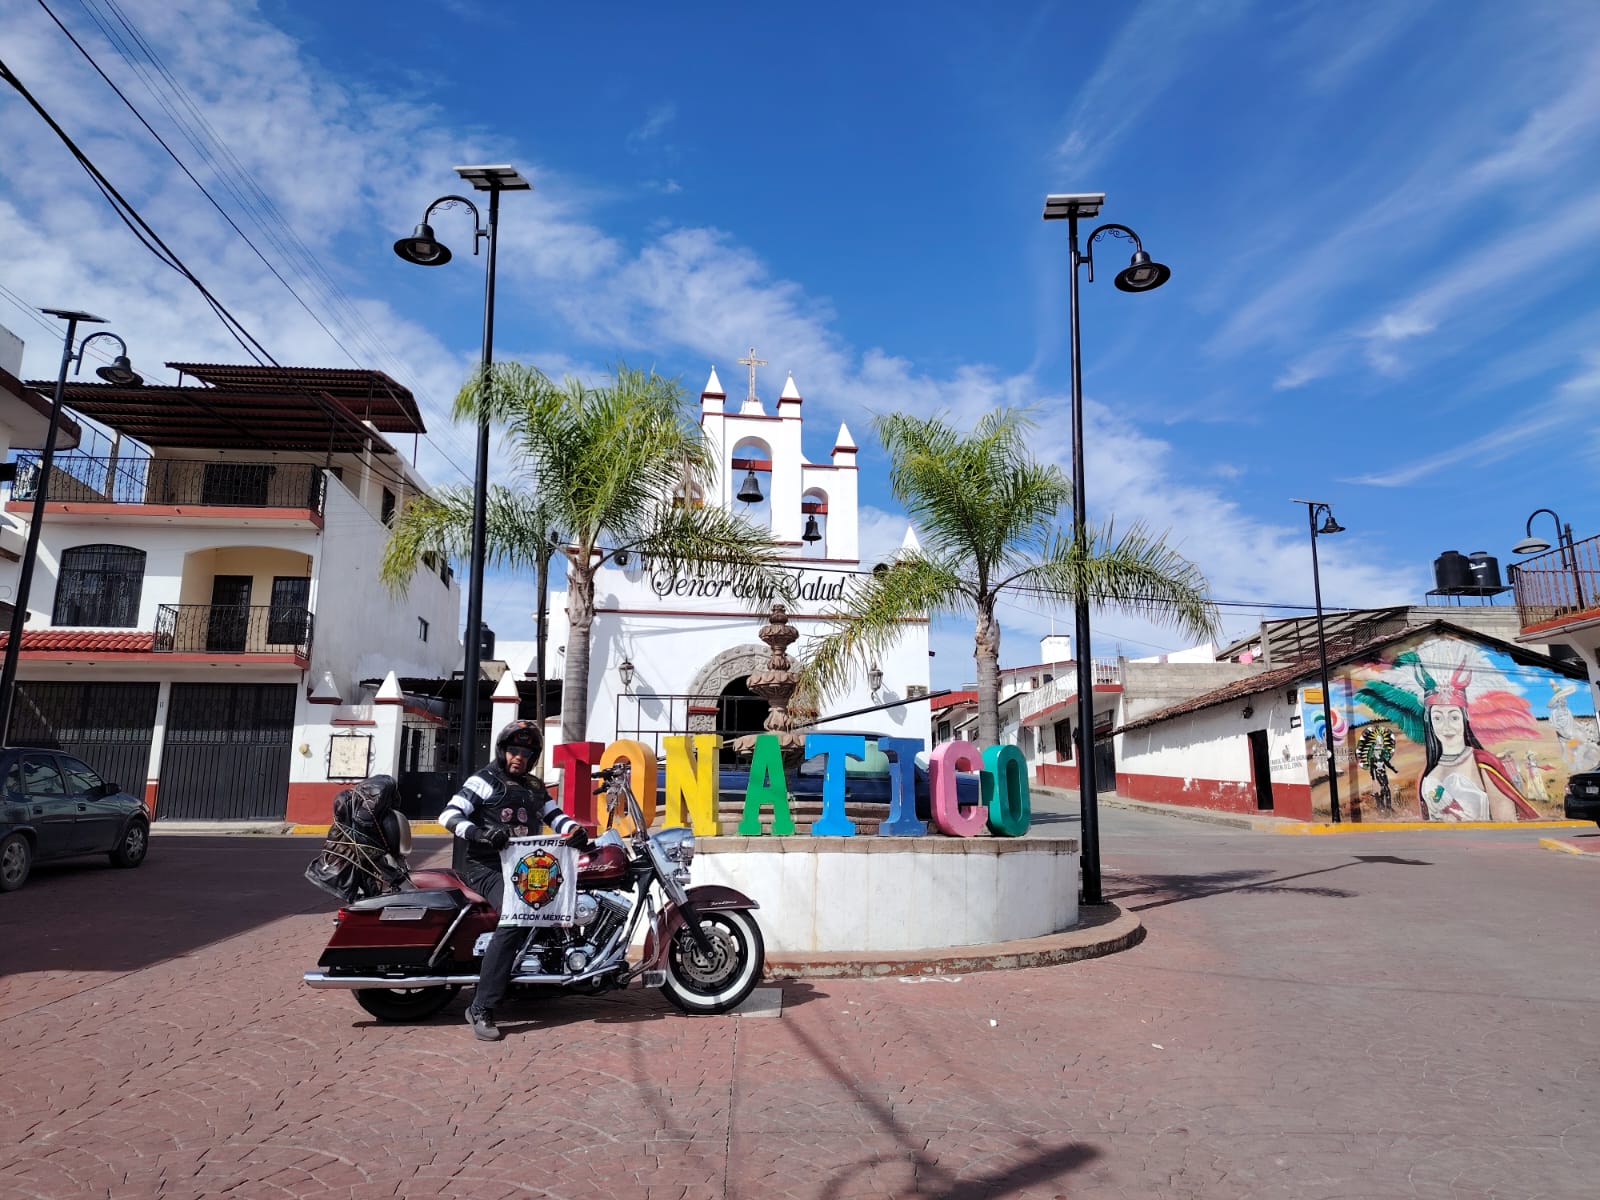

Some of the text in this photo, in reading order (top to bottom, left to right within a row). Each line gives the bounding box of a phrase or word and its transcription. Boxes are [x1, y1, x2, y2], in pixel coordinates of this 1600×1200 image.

[553, 734, 1030, 837] TONATICO
[511, 911, 540, 921] ACCIÓN
[541, 912, 572, 922] MÉXICO
